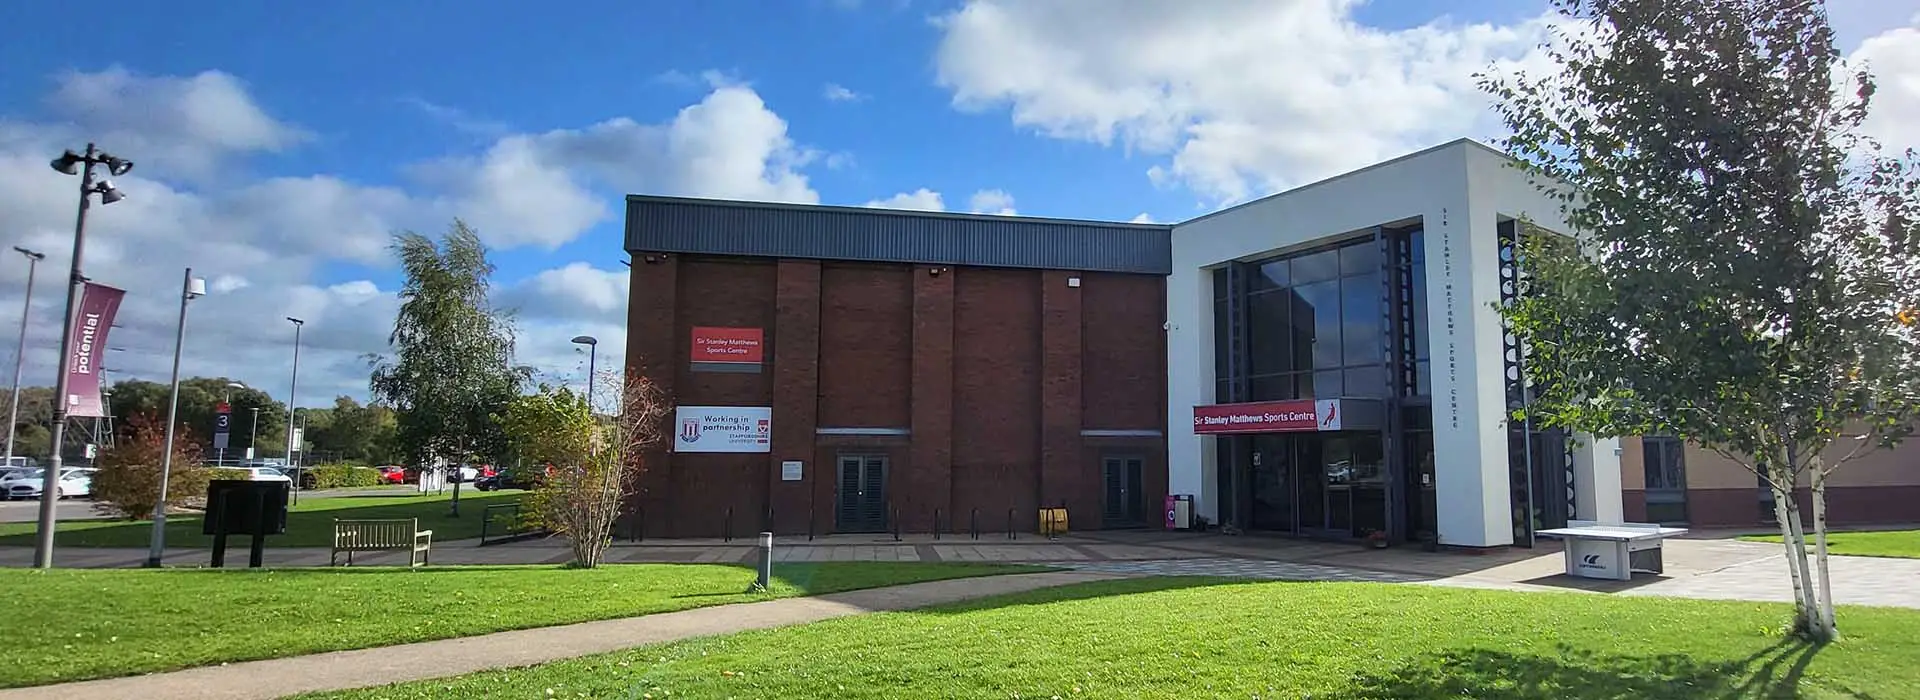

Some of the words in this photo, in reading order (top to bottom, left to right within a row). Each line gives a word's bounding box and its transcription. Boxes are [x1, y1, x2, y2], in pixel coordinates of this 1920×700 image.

[1446, 284, 1454, 335] MATTHEWS
[78, 313, 100, 374] potential
[706, 338, 728, 346] Stanley
[218, 415, 228, 427] 3
[704, 415, 739, 424] Working
[1194, 416, 1203, 425] Sir
[1204, 415, 1229, 425] Stanley
[1229, 414, 1263, 424] Matthews
[1264, 412, 1288, 423] Sports
[1289, 411, 1315, 421] Centre
[703, 424, 750, 432] partnership
